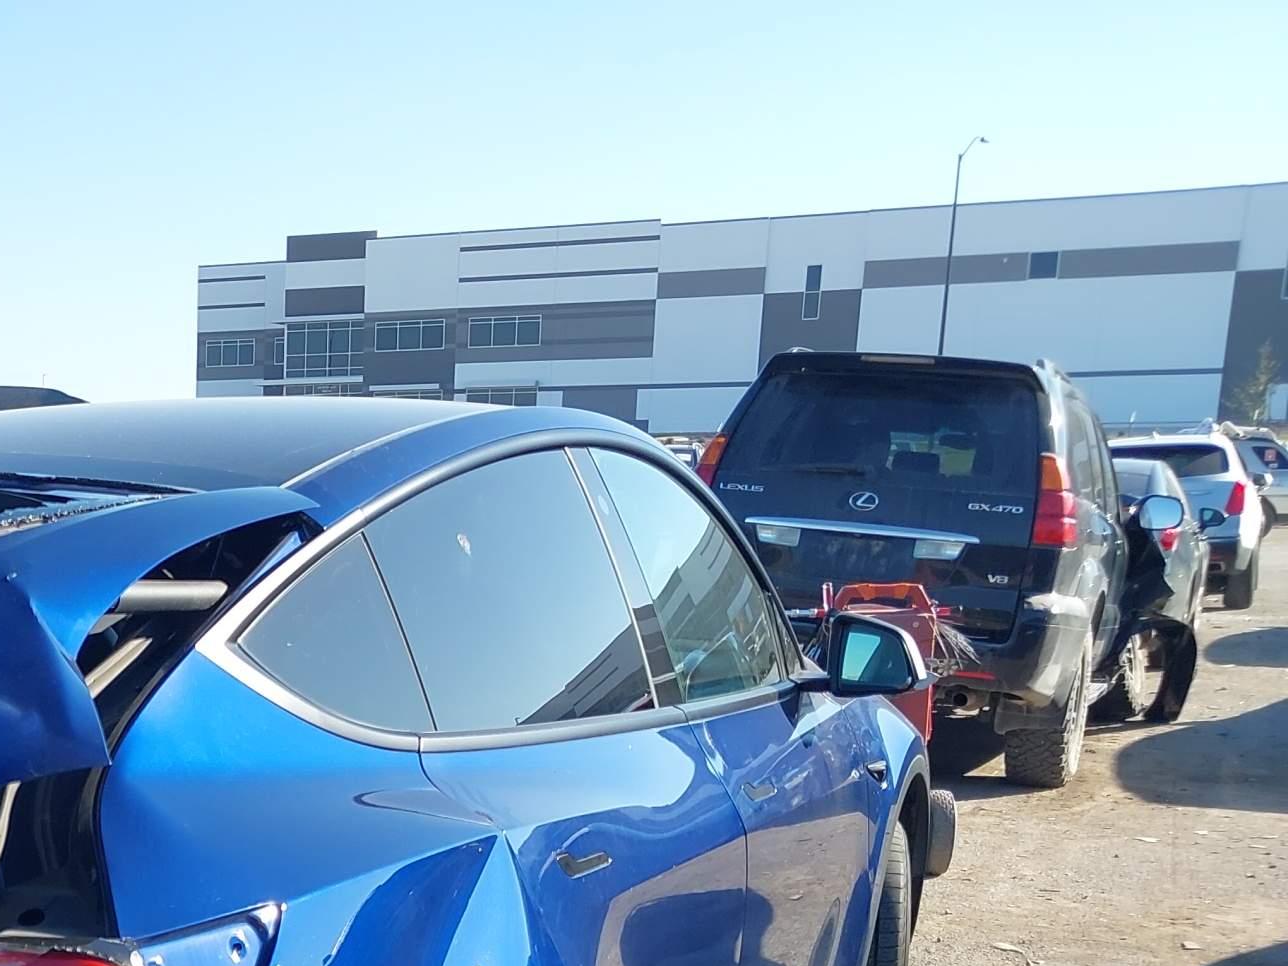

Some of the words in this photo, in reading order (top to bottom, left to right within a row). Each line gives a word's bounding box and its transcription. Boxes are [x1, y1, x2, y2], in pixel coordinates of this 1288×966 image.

[719, 481, 765, 493] LEXUS
[967, 502, 991, 513] GX
[991, 504, 1025, 515] 470
[987, 574, 1009, 584] V8
